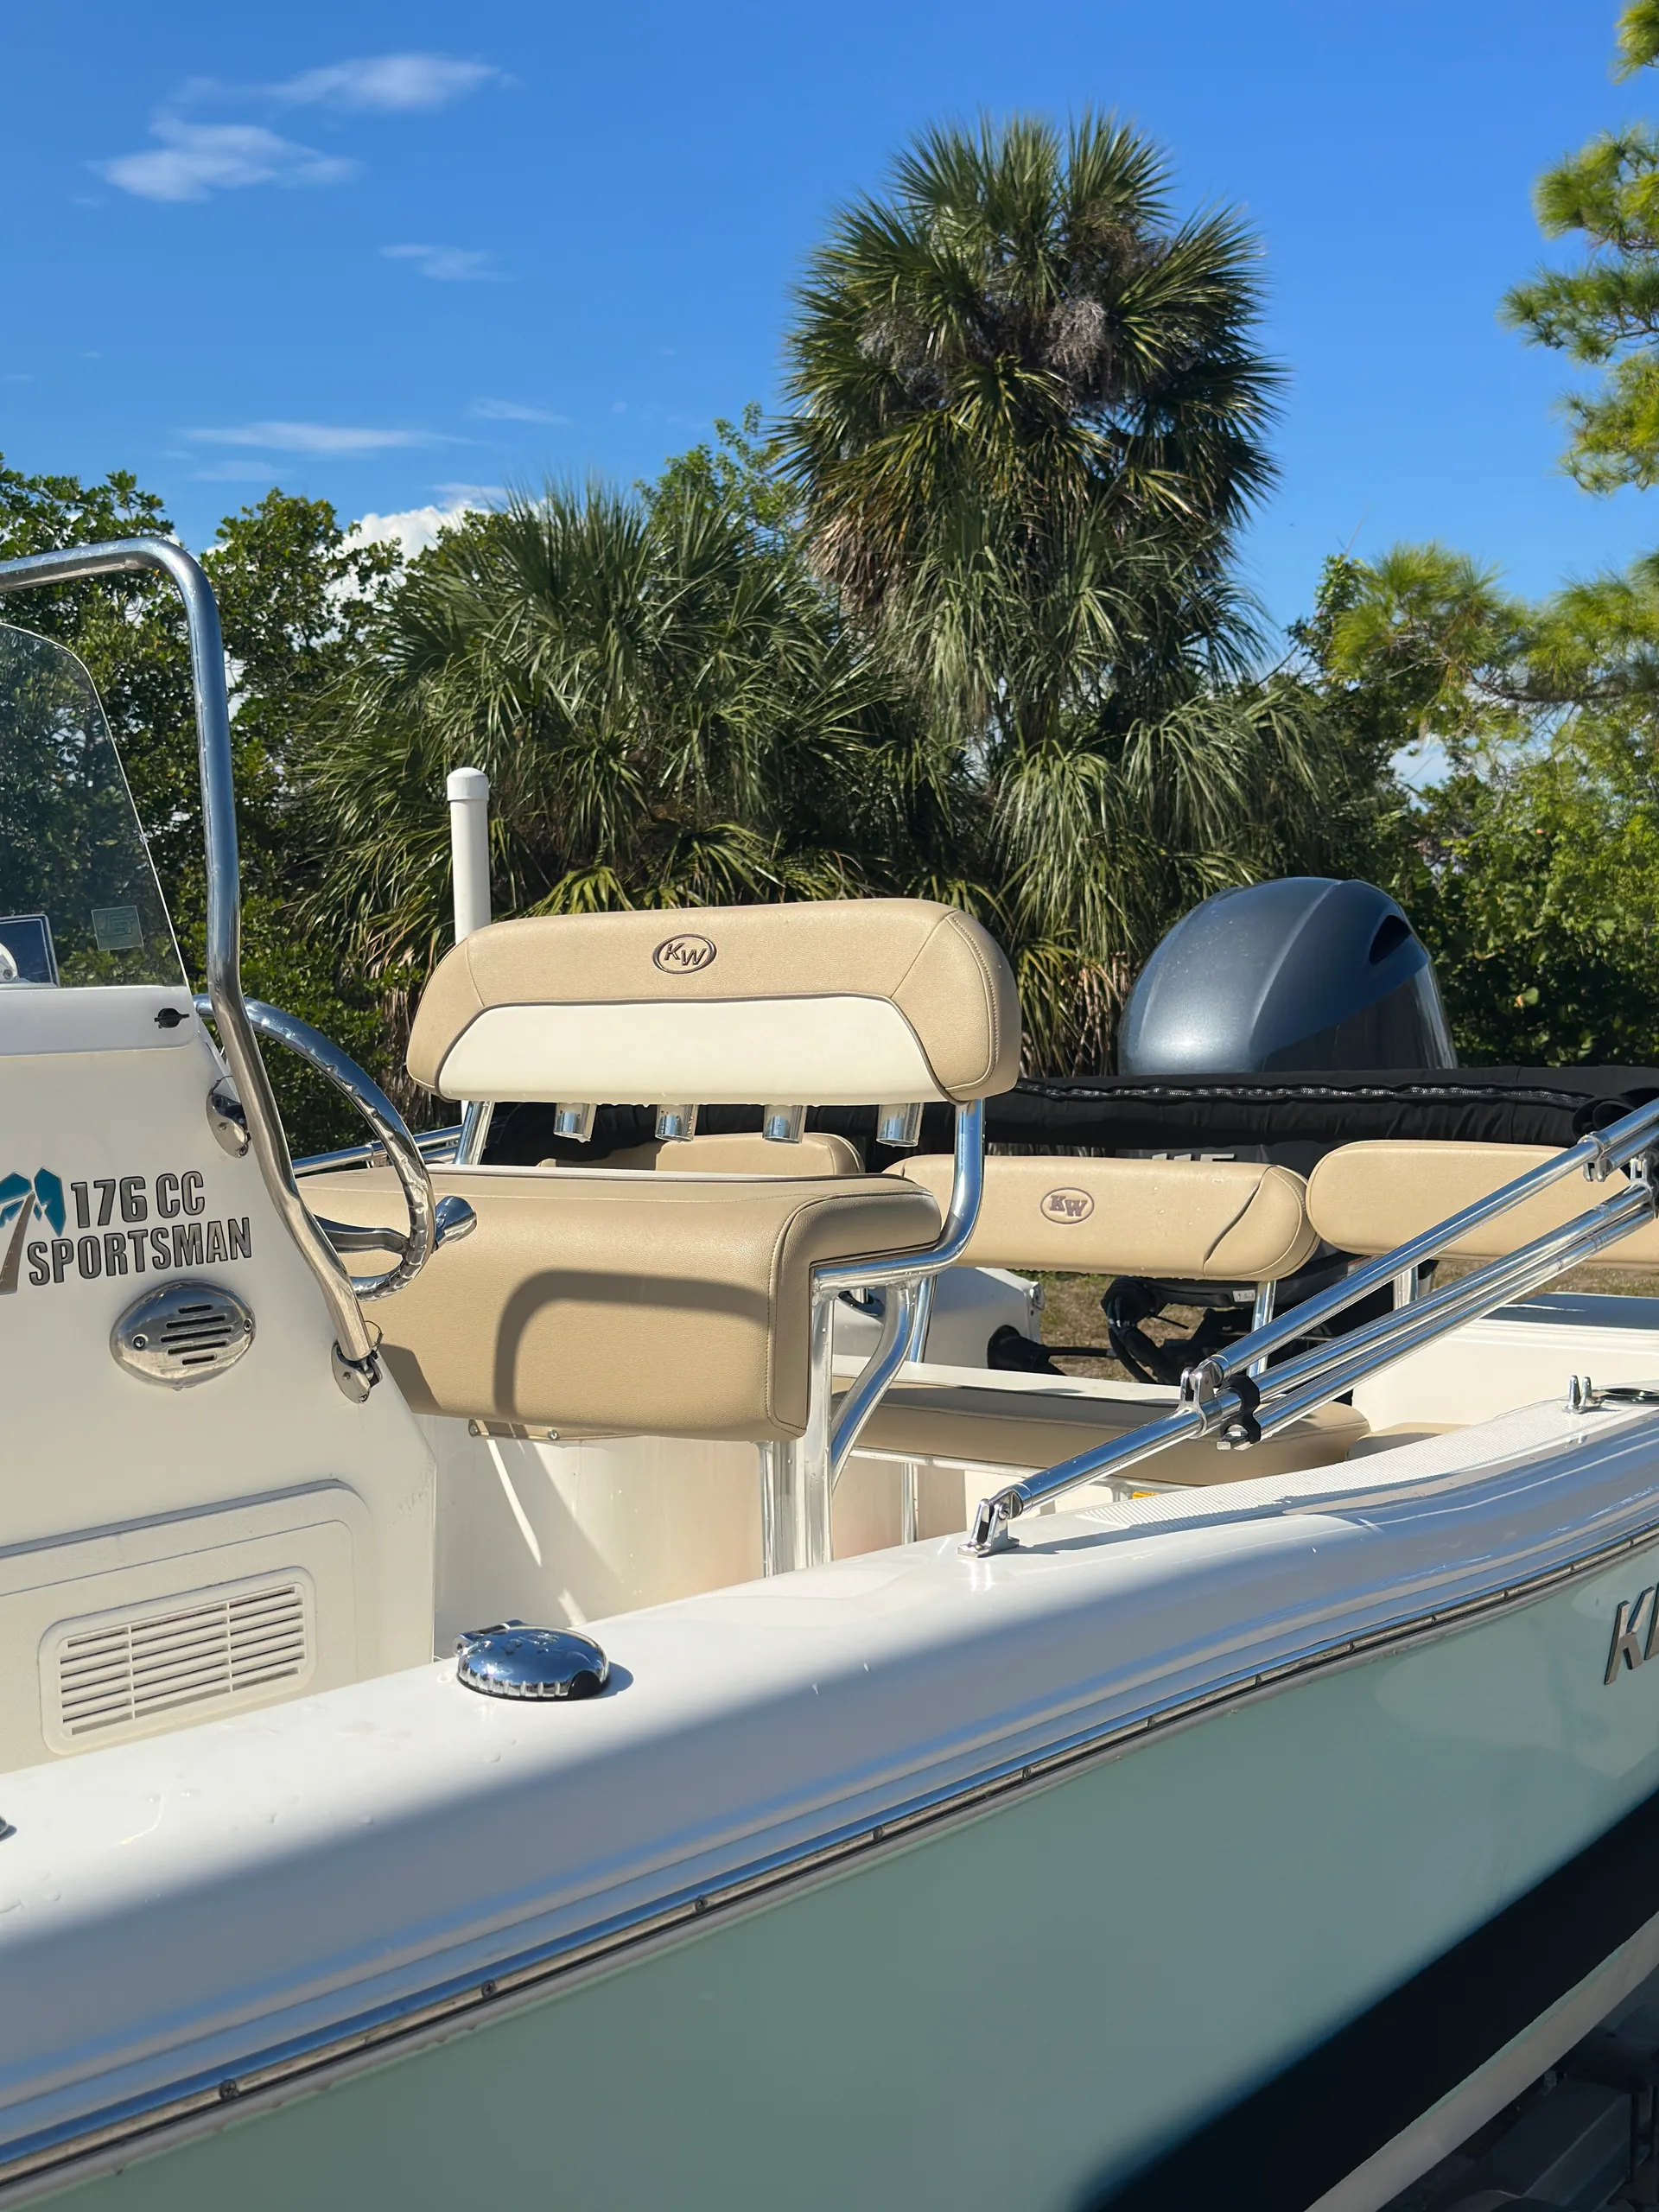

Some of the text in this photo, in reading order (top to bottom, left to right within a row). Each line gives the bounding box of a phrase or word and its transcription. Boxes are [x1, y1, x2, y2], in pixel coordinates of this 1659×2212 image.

[664, 943, 707, 966] KW
[71, 1171, 205, 1229] 176 CC
[1049, 1195, 1088, 1217] KW
[27, 1217, 252, 1286] SPORTSMAN
